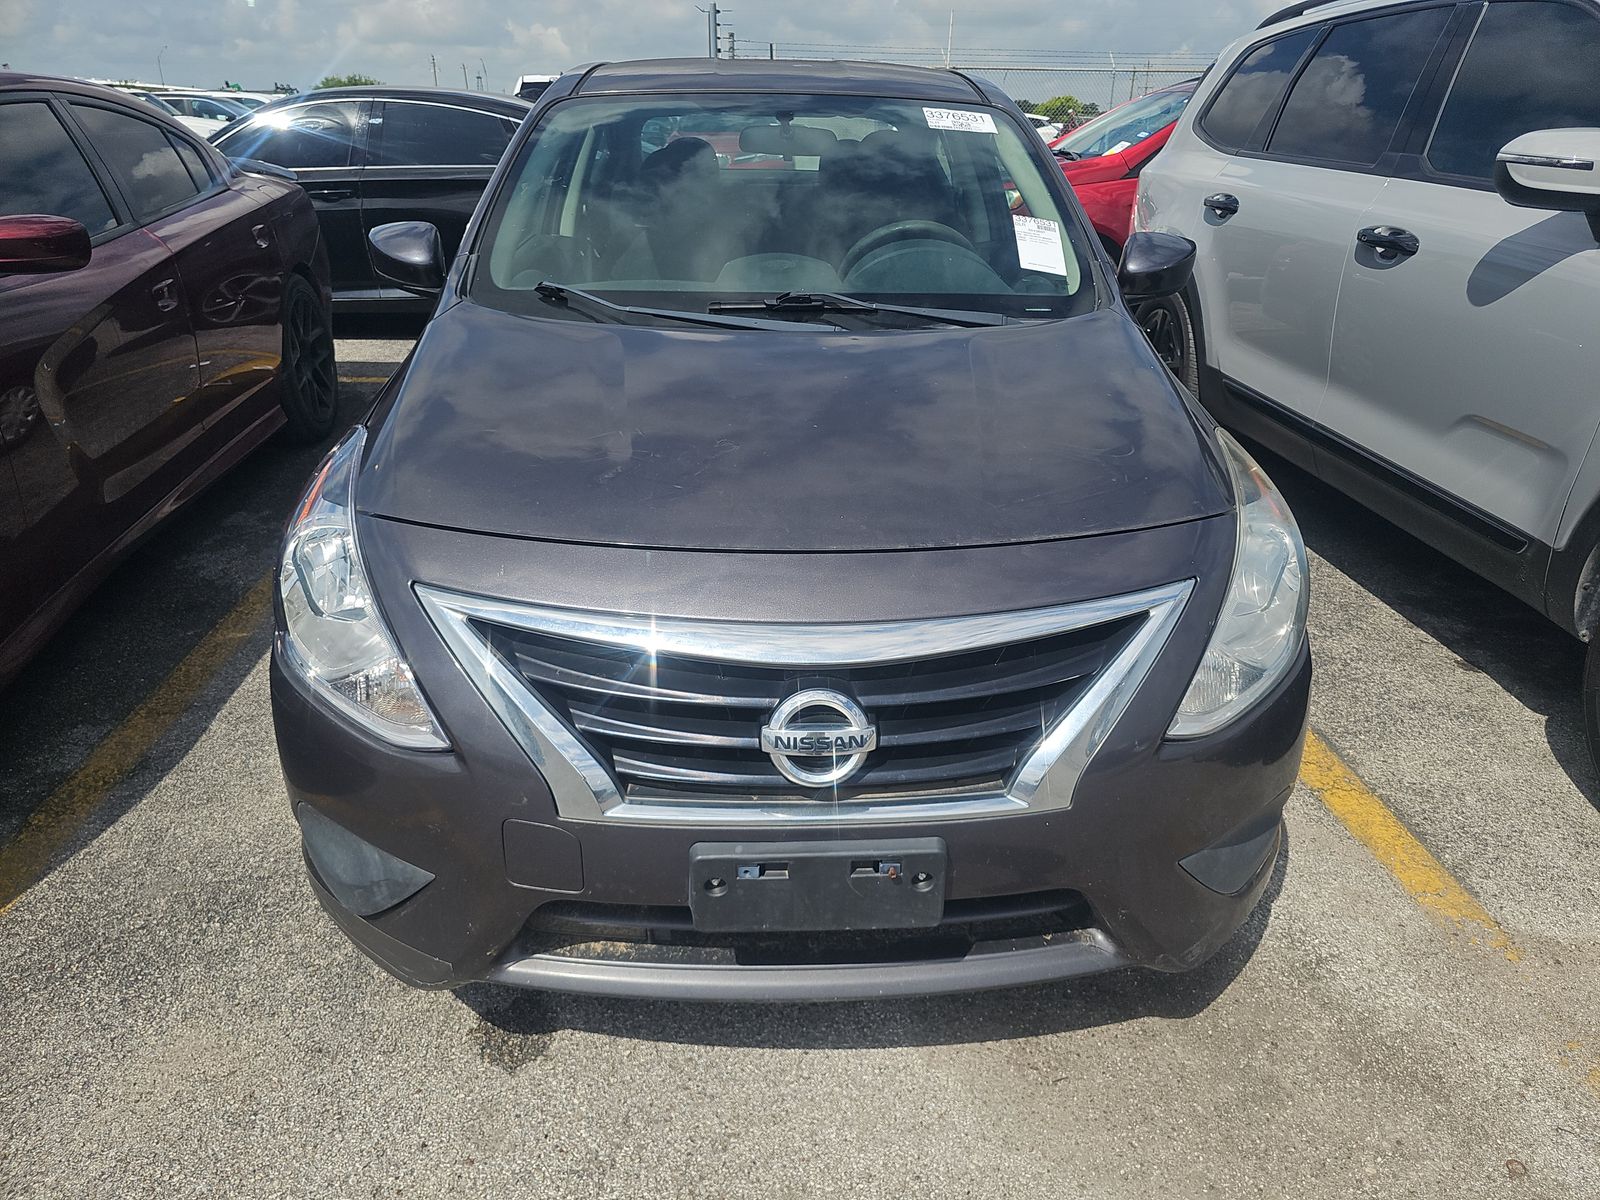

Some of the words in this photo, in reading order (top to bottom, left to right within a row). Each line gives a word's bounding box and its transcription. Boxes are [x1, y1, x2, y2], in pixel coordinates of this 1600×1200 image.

[926, 110, 985, 123] 3376531
[1015, 215, 1056, 227] 3376531
[774, 734, 864, 752] NISSAN
